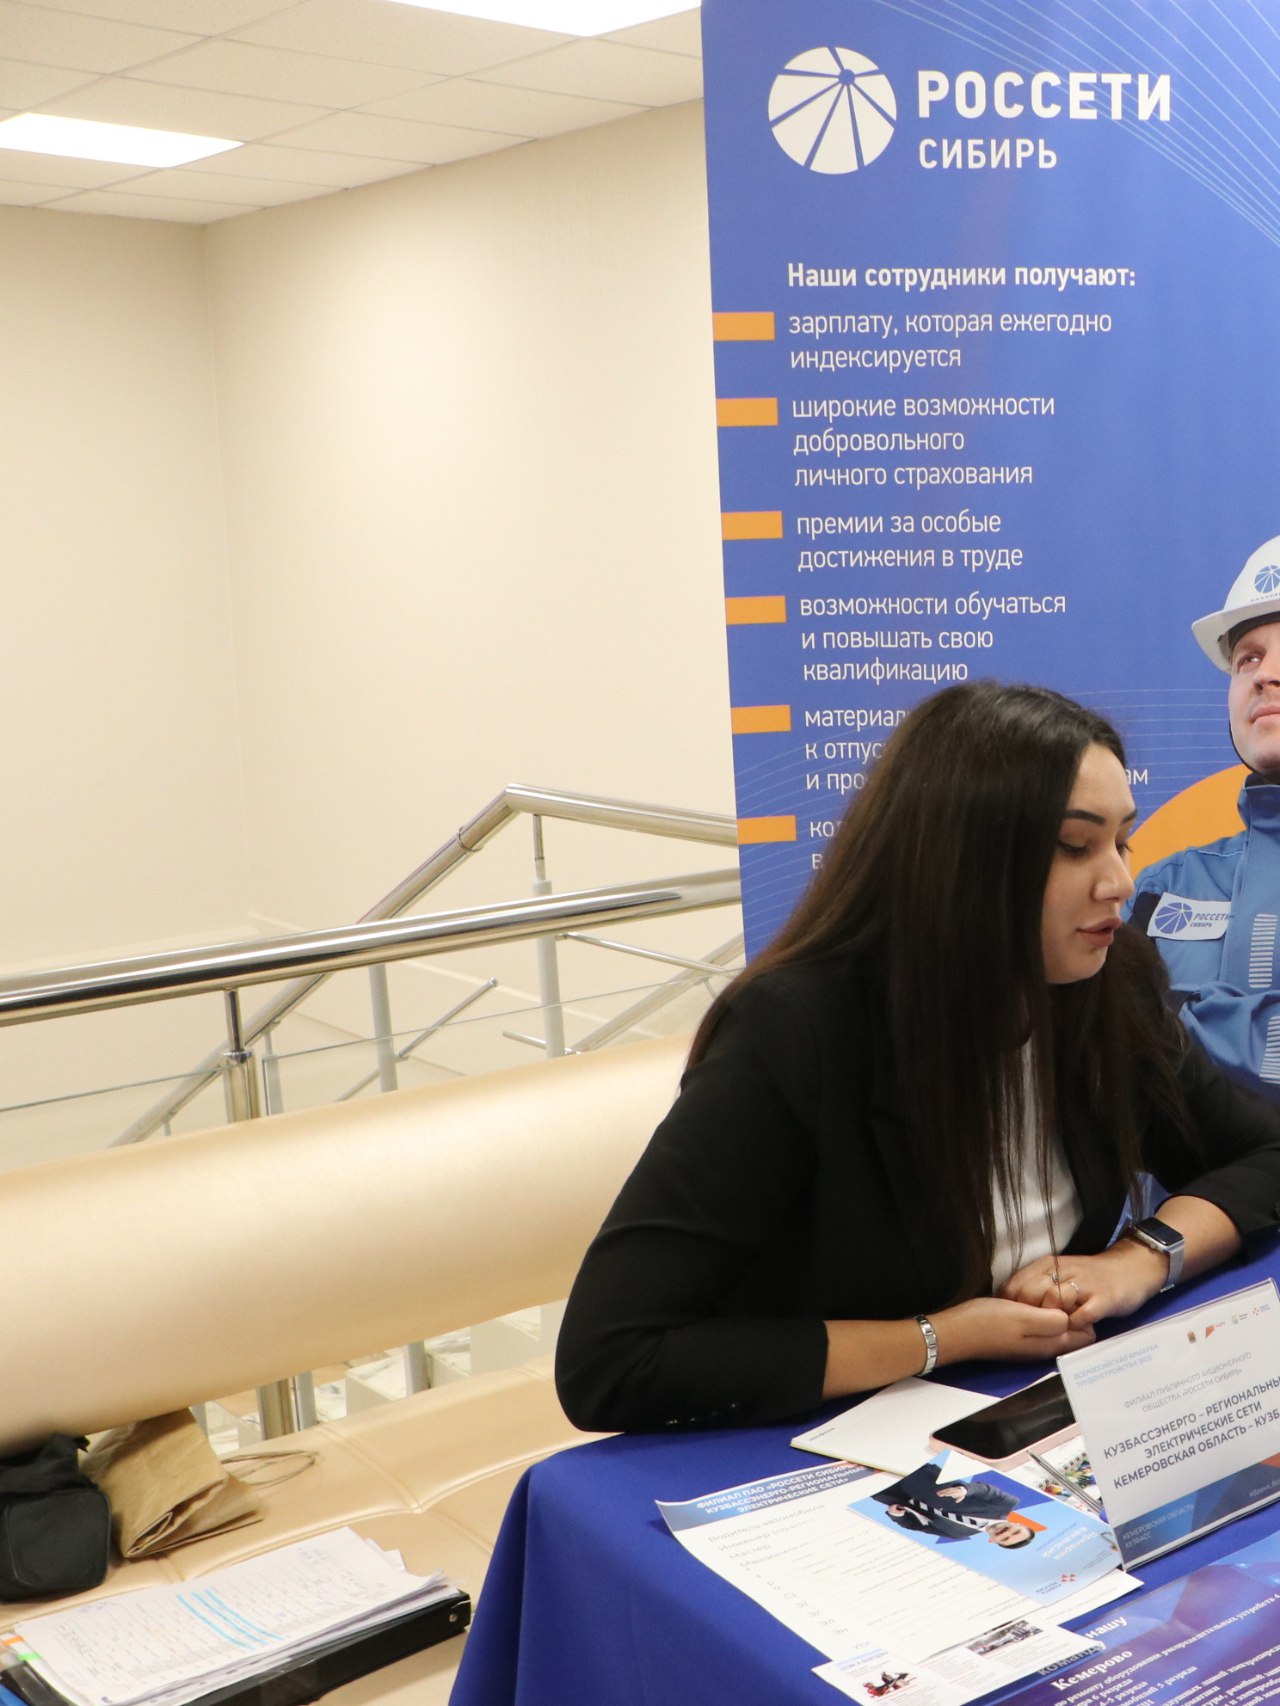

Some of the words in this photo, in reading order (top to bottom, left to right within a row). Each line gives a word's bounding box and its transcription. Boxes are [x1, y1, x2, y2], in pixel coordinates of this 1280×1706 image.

[917, 70, 1171, 122] РОССЕТИ
[919, 138, 1058, 169] СИБИРЬ
[787, 263, 857, 288] Наши
[864, 266, 1006, 292] сотрудники
[1014, 265, 1137, 290] получают:
[788, 314, 899, 337] зарплату,
[905, 312, 993, 336] которая
[1000, 312, 1112, 335] ежегодно
[790, 346, 961, 373] индексируется
[793, 398, 896, 420] широкие
[903, 396, 1055, 416] возможности
[793, 429, 965, 456] добровольного
[794, 466, 887, 487] личного
[893, 465, 1033, 489] страхования
[797, 514, 884, 537] премии
[890, 514, 915, 533] за
[921, 509, 1001, 533] особые
[798, 546, 935, 571] достижения
[942, 549, 955, 566] в
[960, 546, 1023, 570] труде
[800, 596, 948, 616] возможности
[954, 592, 1066, 619] обучаться
[802, 631, 816, 649] и
[823, 629, 932, 649] повышать
[938, 630, 993, 648] свою
[803, 659, 968, 684] квалификацию
[805, 708, 903, 731] материал
[805, 743, 817, 759] к
[824, 742, 883, 764] отпус
[806, 774, 820, 790] и
[1104, 1413, 1196, 1459] КУЗБАССЭНЕРГО
[1144, 1412, 1235, 1459] ЭЛЕКТРИЧЕСКИЕ
[1236, 1401, 1262, 1419] СЕТИ
[1113, 1446, 1196, 1489] КЕМЕРОВСКАЯ
[1197, 1425, 1247, 1452] ОБЛАСТЬ
[697, 1489, 741, 1508] ФИЛИАЛ
[743, 1485, 765, 1498] ПАО
[736, 1487, 819, 1513] ЭЛЕКТРИЧЕСКИЕ
[1084, 1616, 1128, 1639] нашу
[1051, 1651, 1133, 1690] Кемерово
